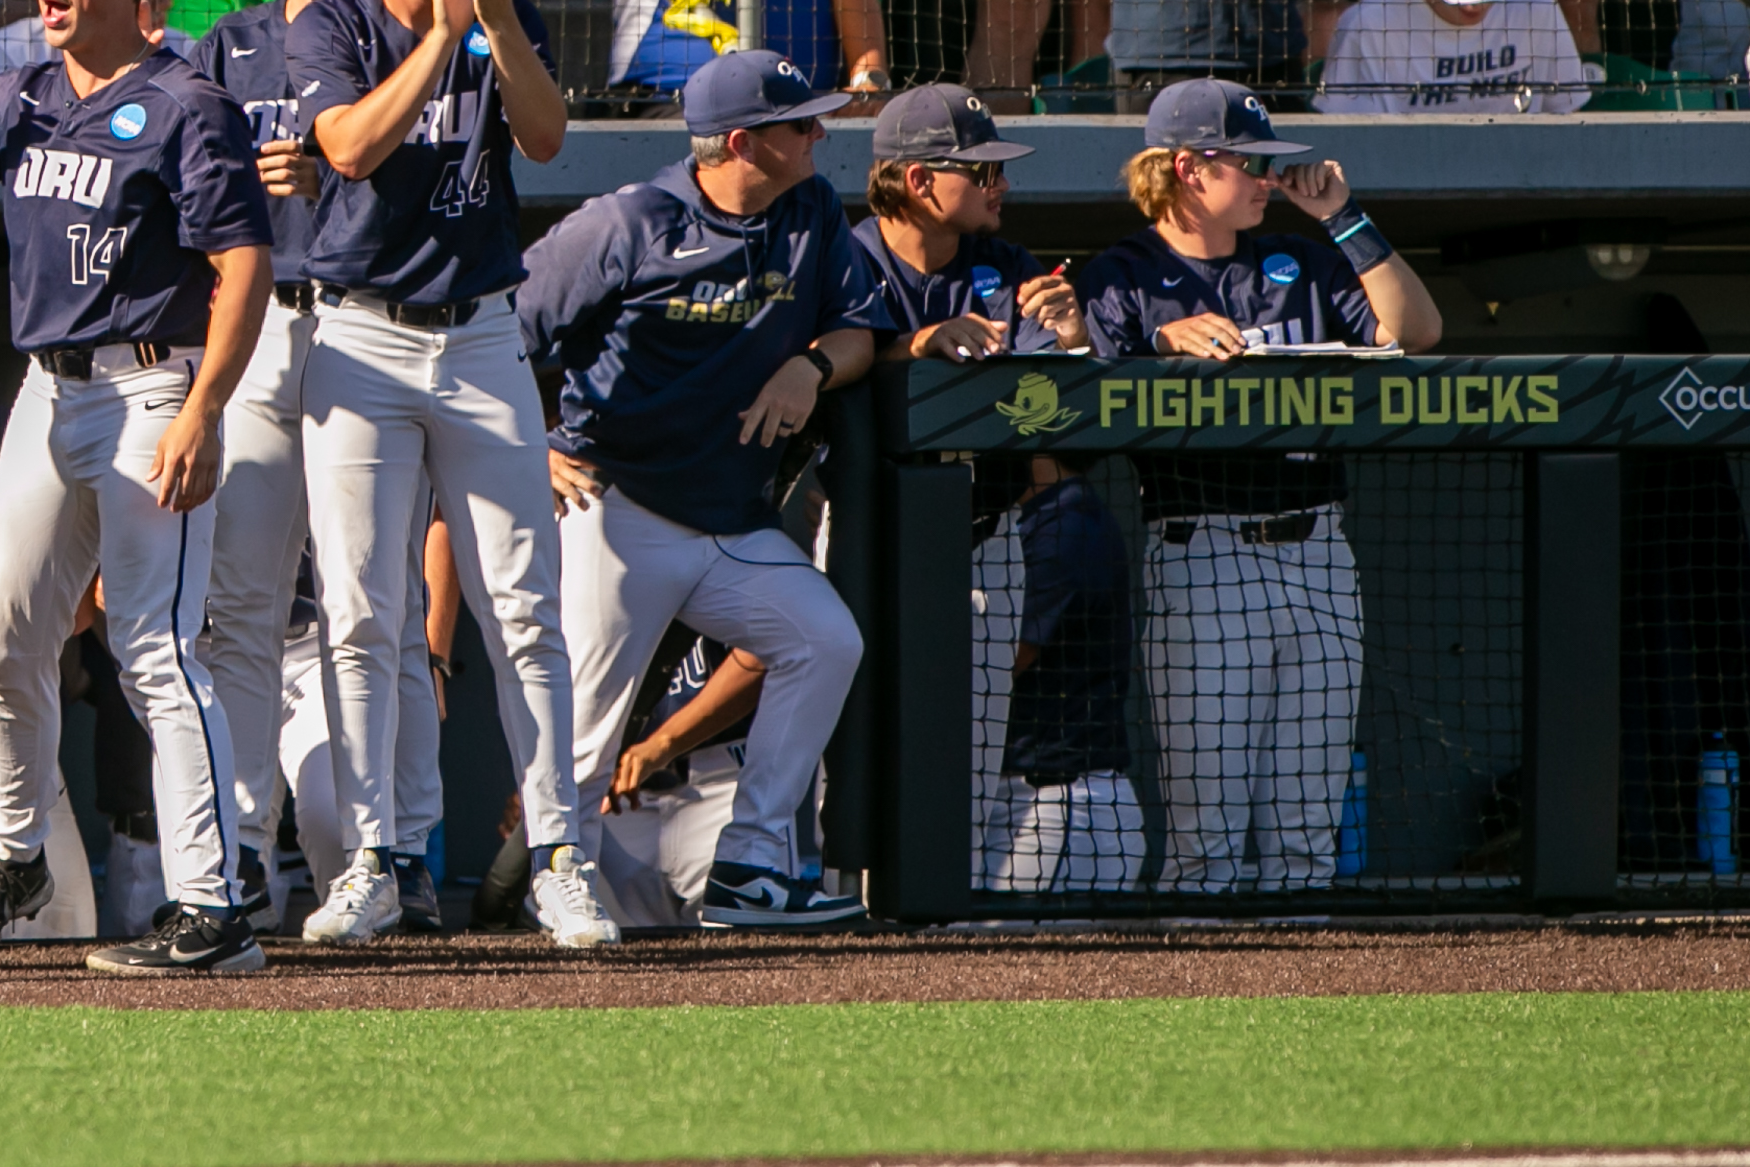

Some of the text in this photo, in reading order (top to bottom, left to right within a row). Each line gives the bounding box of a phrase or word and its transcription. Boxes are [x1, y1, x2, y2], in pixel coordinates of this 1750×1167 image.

[1436, 44, 1517, 80] BUILD
[13, 146, 113, 210] ORU
[429, 148, 491, 218] 44
[66, 222, 129, 286] 14
[1099, 375, 1560, 428] FIGHTING DUCKS
[1676, 386, 1750, 411] OCCU
